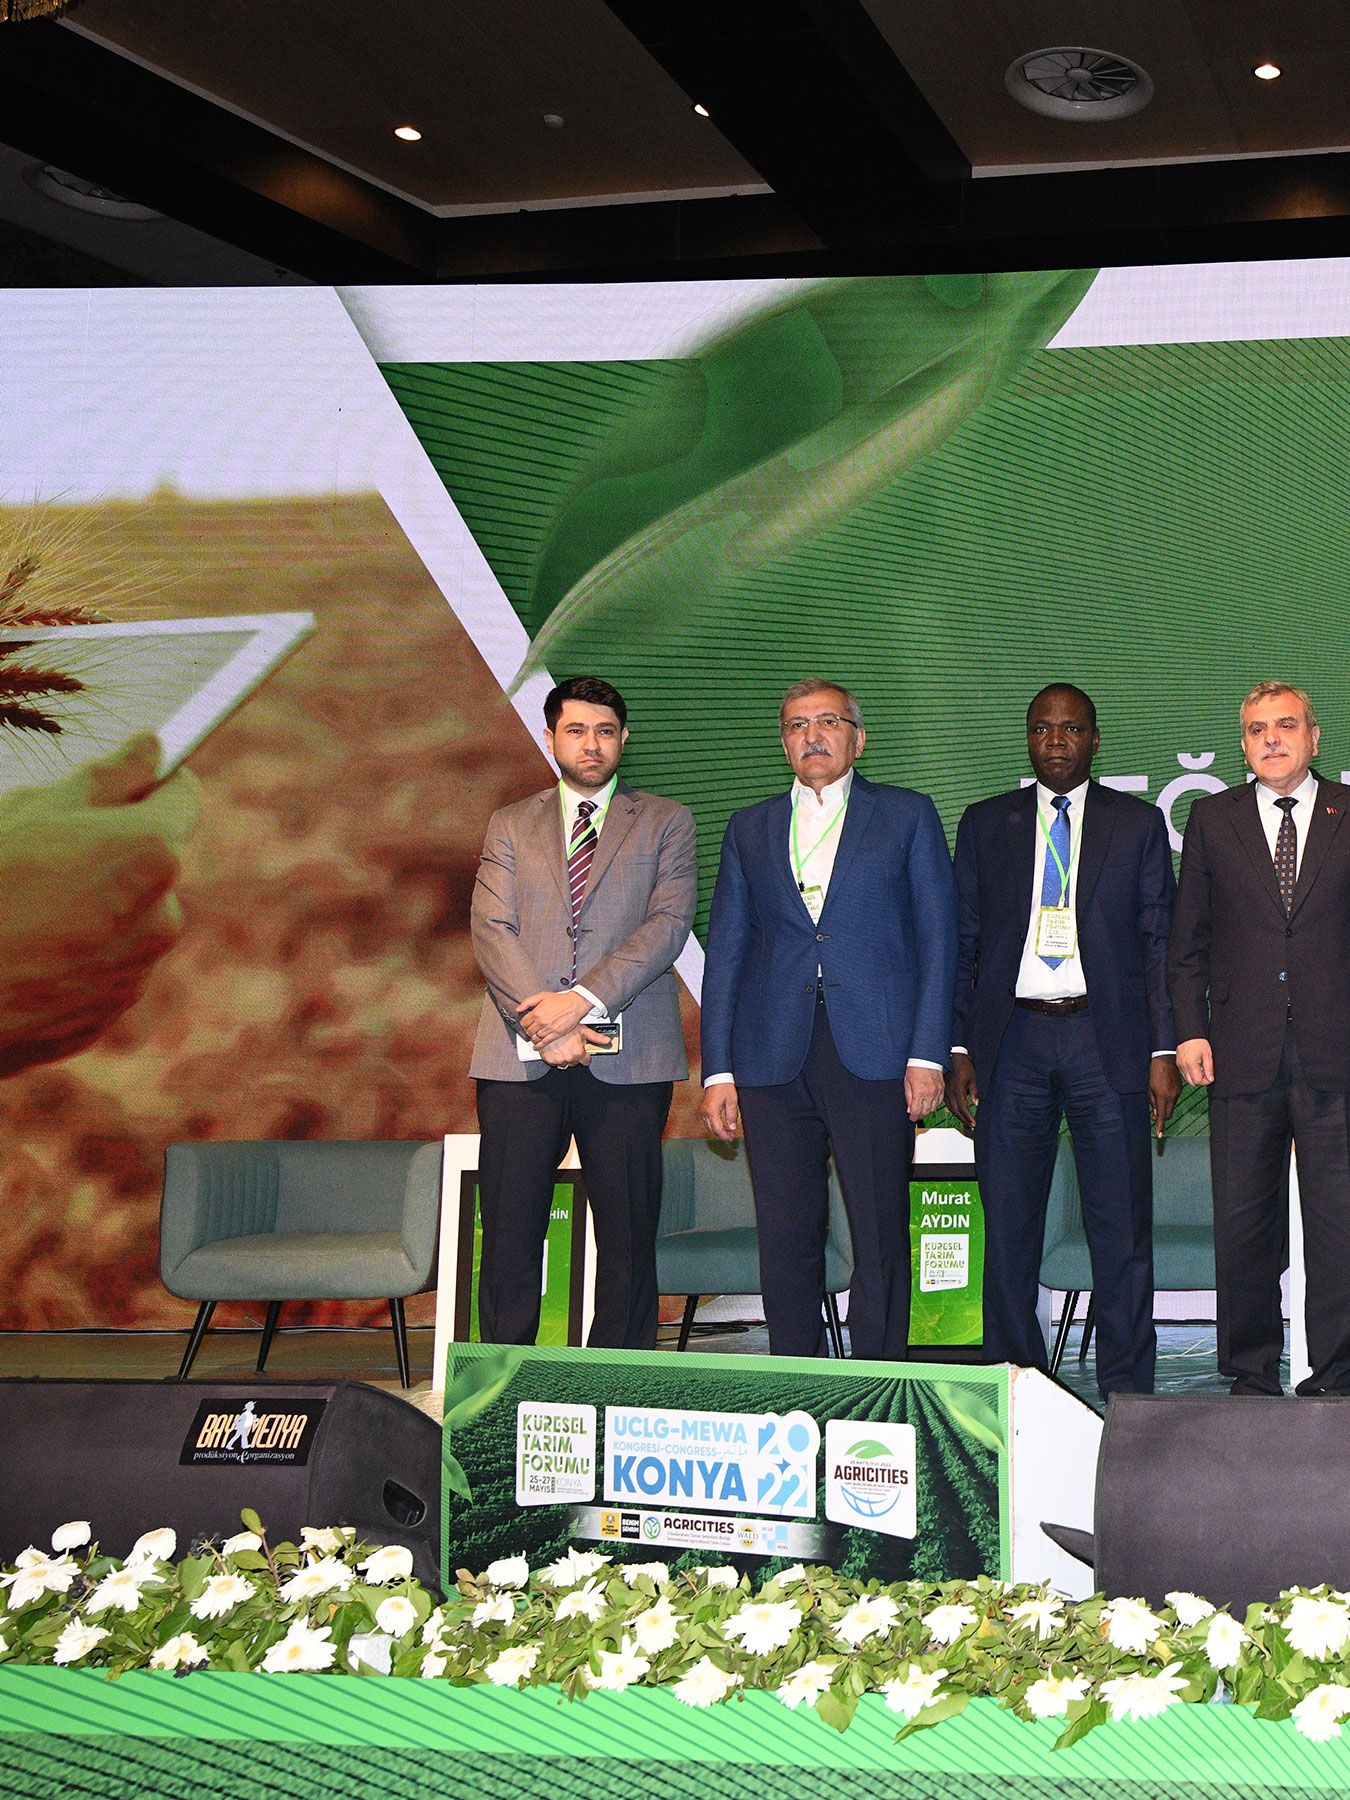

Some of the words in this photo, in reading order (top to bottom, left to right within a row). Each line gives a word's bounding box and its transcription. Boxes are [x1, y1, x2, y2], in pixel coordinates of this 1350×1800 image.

[921, 1191, 971, 1205] Murat
[549, 1208, 569, 1220] HİN
[920, 1214, 970, 1229] AYDIN
[195, 1414, 240, 1448] BAY
[247, 1414, 308, 1449] MEDYA
[523, 1414, 587, 1434] KÜRESEL
[614, 1415, 748, 1444] UCLG-MEWA
[523, 1434, 573, 1453] TARIM
[247, 1451, 295, 1461] organizasyon
[529, 1475, 550, 1484] 25-27
[613, 1455, 747, 1502] KONYA
[834, 1465, 909, 1485] AGRICITIES
[529, 1484, 551, 1493] MAYIS
[664, 1517, 734, 1534] AGRICITIES
